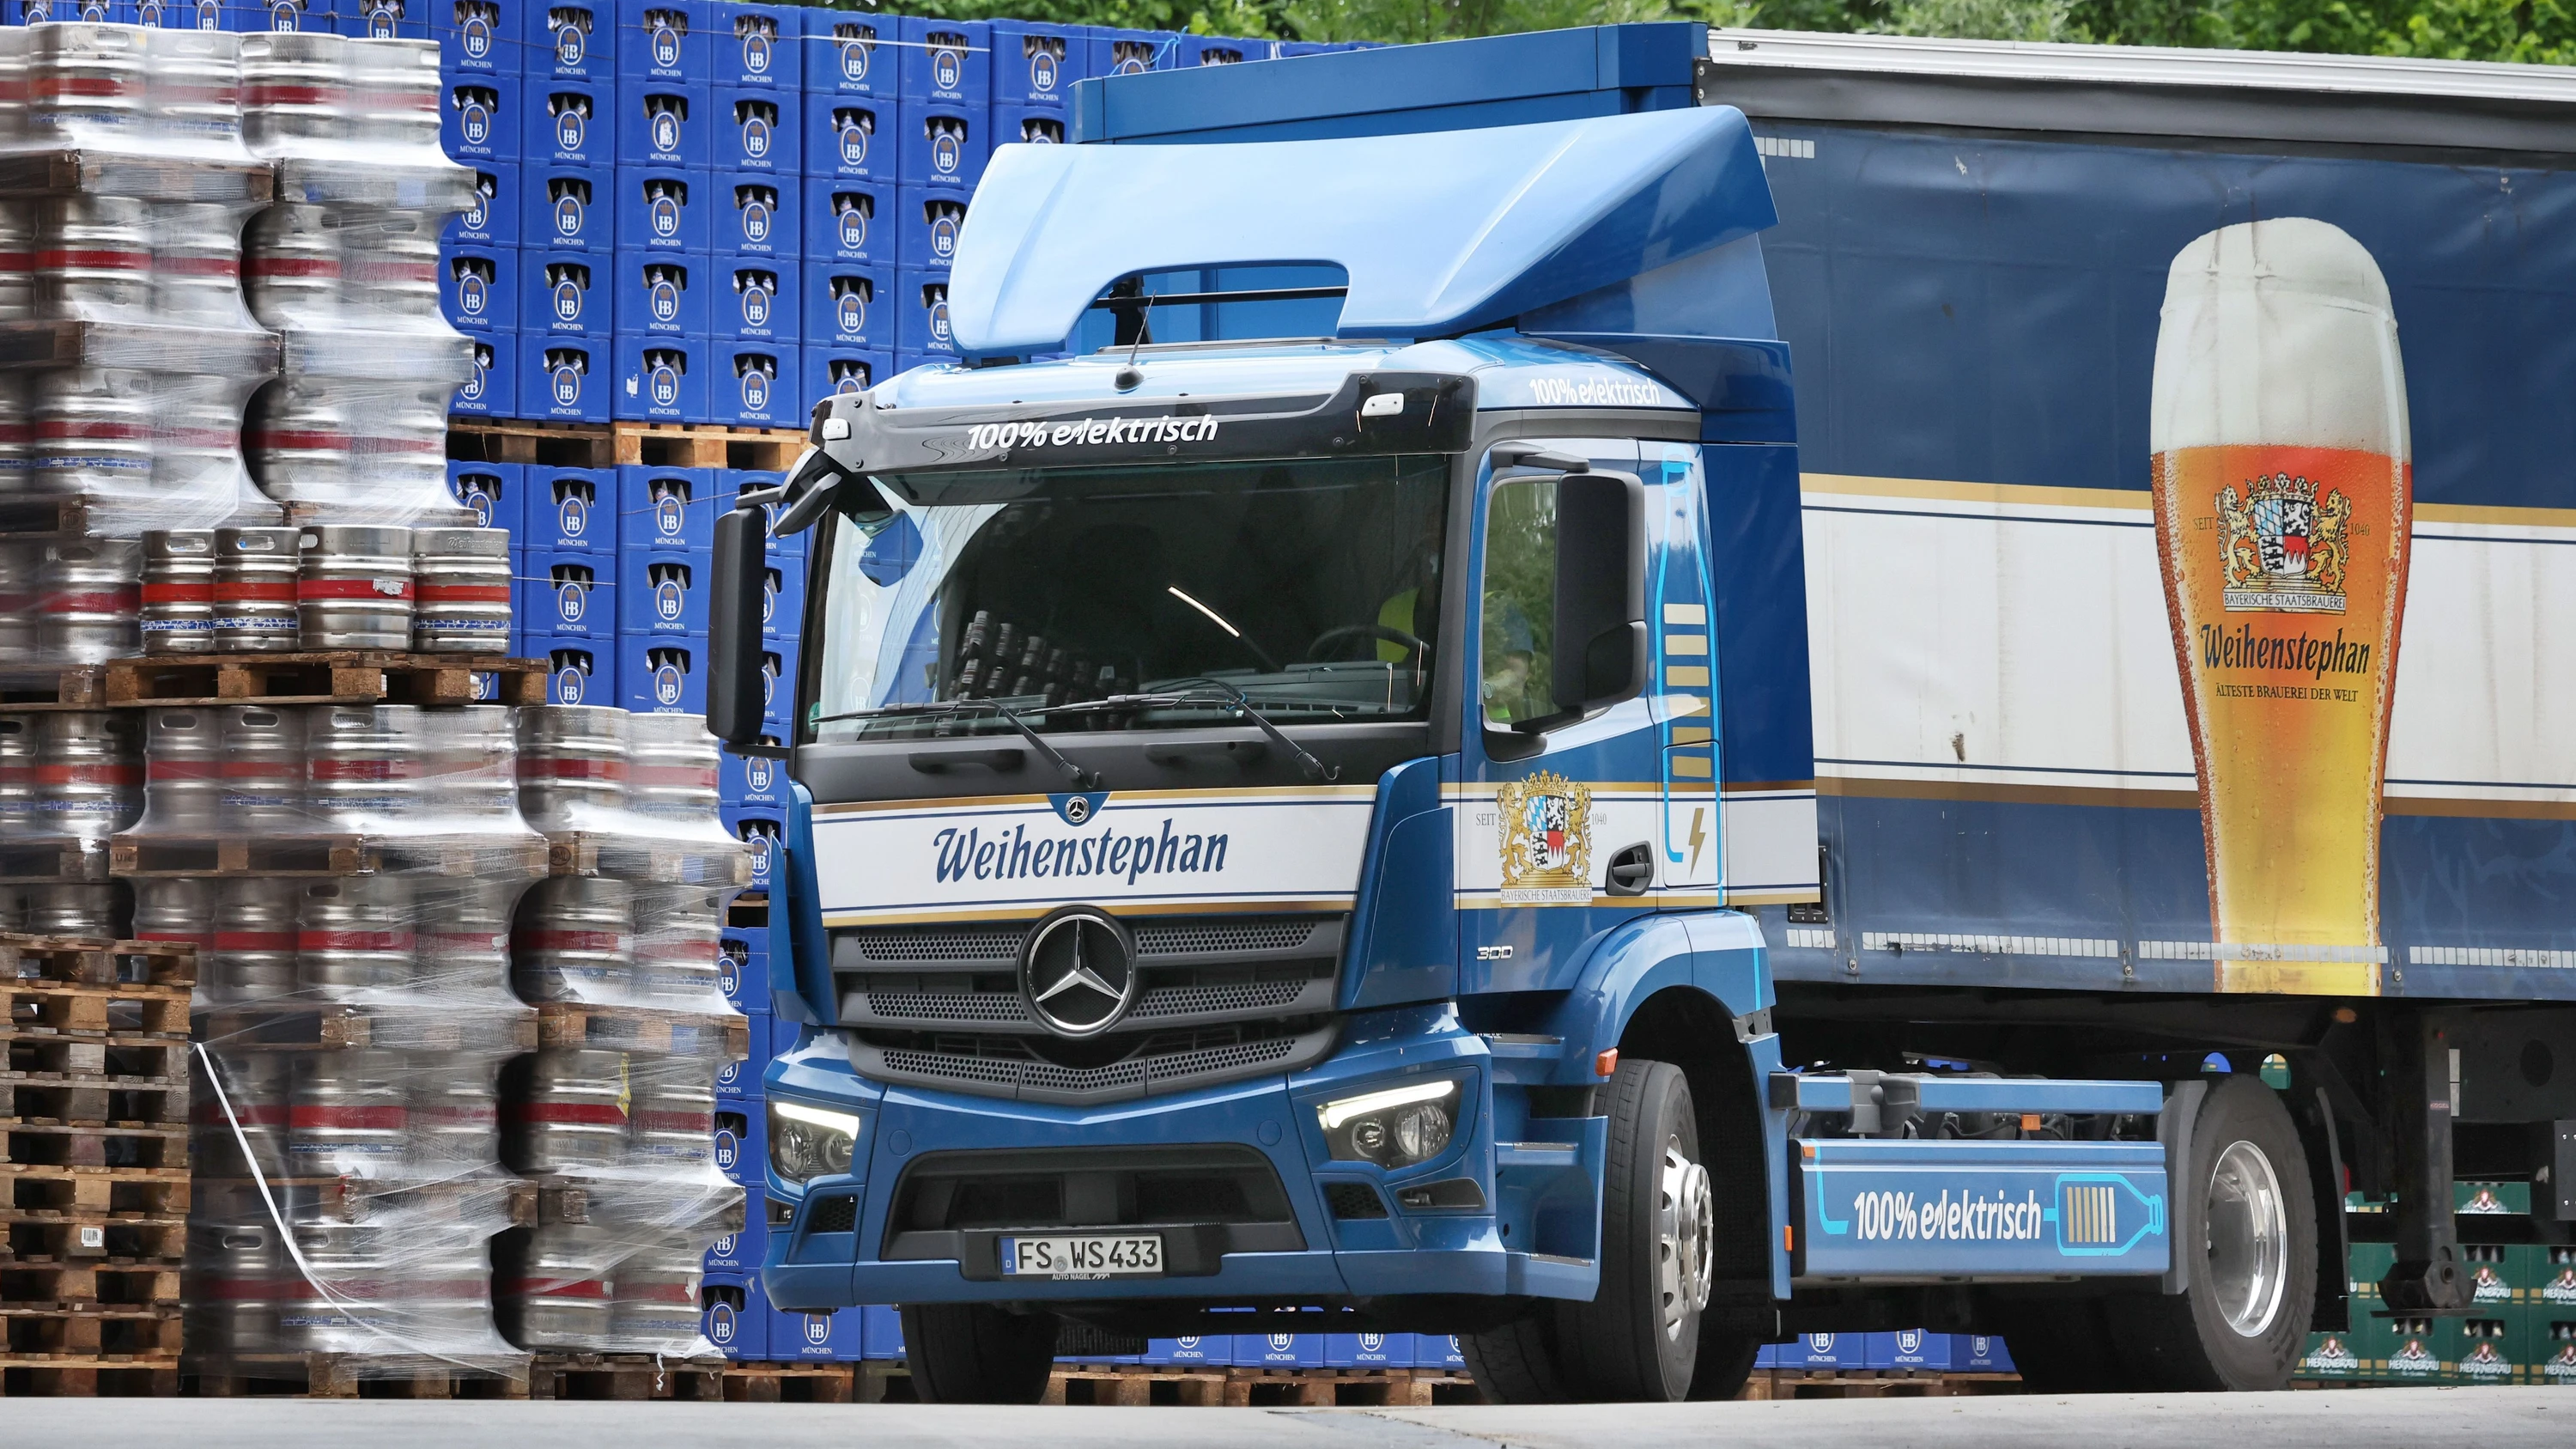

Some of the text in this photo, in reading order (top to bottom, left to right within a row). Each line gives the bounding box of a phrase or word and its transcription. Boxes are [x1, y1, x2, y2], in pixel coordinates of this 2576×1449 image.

[470, 36, 484, 52] HB
[659, 46, 674, 61] HB
[460, 58, 493, 69] MÜNCHEN
[750, 53, 764, 69] HB
[848, 59, 862, 75] HB
[555, 65, 586, 76] MÜNCHEN
[650, 67, 682, 77] MÜNCHEN
[940, 68, 955, 83] HB
[741, 74, 773, 83] MÜNCHEN
[1037, 70, 1052, 86] HB
[839, 81, 870, 91] MÜNCHEN
[932, 89, 963, 100] MÜNCHEN
[1028, 91, 1059, 101] MÜNCHEN
[468, 122, 483, 138] HB
[563, 129, 578, 145] HB
[459, 144, 491, 155] MÜNCHEN
[749, 137, 764, 152] HB
[554, 150, 586, 161] MÜNCHEN
[649, 152, 682, 162] MÜNCHEN
[846, 143, 861, 159] HB
[740, 158, 772, 167] MÜNCHEN
[939, 152, 954, 167] HB
[837, 165, 869, 175] MÜNCHEN
[930, 174, 961, 184] MÜNCHEN
[562, 214, 577, 230] HB
[659, 215, 673, 231] HB
[749, 221, 764, 236] HB
[459, 230, 490, 240] MÜNCHEN
[553, 236, 585, 246] MÜNCHEN
[845, 228, 860, 243] HB
[650, 237, 682, 247] MÜNCHEN
[740, 242, 772, 252] MÜNCHEN
[938, 235, 952, 252] HB
[836, 249, 868, 259] MÜNCHEN
[929, 258, 952, 266] MÜNCH
[465, 293, 481, 309] HB
[561, 299, 575, 315] HB
[658, 300, 672, 315] HB
[749, 305, 763, 320] HB
[457, 315, 489, 326] MÜNCHEN
[844, 312, 859, 327] HB
[552, 321, 584, 331] MÜNCHEN
[649, 321, 681, 332] MÜNCHEN
[740, 326, 772, 336] MÜNCHEN
[835, 333, 866, 344] MÜNCHEN
[927, 342, 952, 350] MÜNCH
[559, 384, 574, 400] HB
[657, 385, 672, 400] HB
[1528, 376, 1662, 405] 100% elektrisch
[748, 389, 763, 405] HB
[455, 400, 487, 411] MÜNCHEN
[550, 406, 582, 416] MÜNCHEN
[649, 406, 680, 416] MÜNCHEN
[739, 411, 771, 421] MÜNCHEN
[967, 413, 1219, 450] 100% elektrisch
[566, 515, 580, 531] HB
[663, 514, 677, 530] HB
[2193, 516, 2215, 532] SEIT
[557, 538, 588, 547] MÜNCHEN
[654, 536, 686, 545] MÜNCHEN
[662, 599, 677, 614] HB
[2224, 593, 2346, 609] BAYERISCHE STAATSBRAUEREI
[564, 600, 580, 616] HB
[556, 623, 587, 632] MÜNCHEN
[653, 621, 685, 630] MÜNCHEN
[2200, 622, 2371, 680] Weihenstephan
[563, 685, 578, 701] HB
[2215, 682, 2359, 703] ÄLTESTE BRAUEREI DER WELT
[653, 706, 684, 715] MÜNCHEN
[752, 771, 767, 786] HB
[744, 792, 775, 801] MÜNCHEN
[1475, 813, 1497, 826] SEIT
[1591, 813, 1607, 825] 1040
[933, 817, 1230, 886] Weihenstephan
[1501, 888, 1593, 901] BAYERISCHE STAATSBRAUEREI
[715, 1086, 742, 1094] ÜNCHEN
[718, 1148, 732, 1164] HB
[1853, 1189, 2042, 1240] 100% elektrisch
[1018, 1241, 1053, 1269] FS
[708, 1257, 739, 1267] MÜNCHEN
[1005, 1259, 1012, 1269] D
[715, 1322, 730, 1337] HB
[810, 1324, 824, 1339] HB
[1902, 1333, 1916, 1348] HB
[801, 1345, 833, 1355] MÜNCHEN
[1173, 1349, 1204, 1358] MÜNCHEN
[1265, 1352, 1296, 1361] MÜNCHEN
[1356, 1352, 1387, 1361] MÜNCHEN
[1807, 1353, 1837, 1362] MÜNCHEN
[1894, 1354, 1924, 1363] MÜNCHEN
